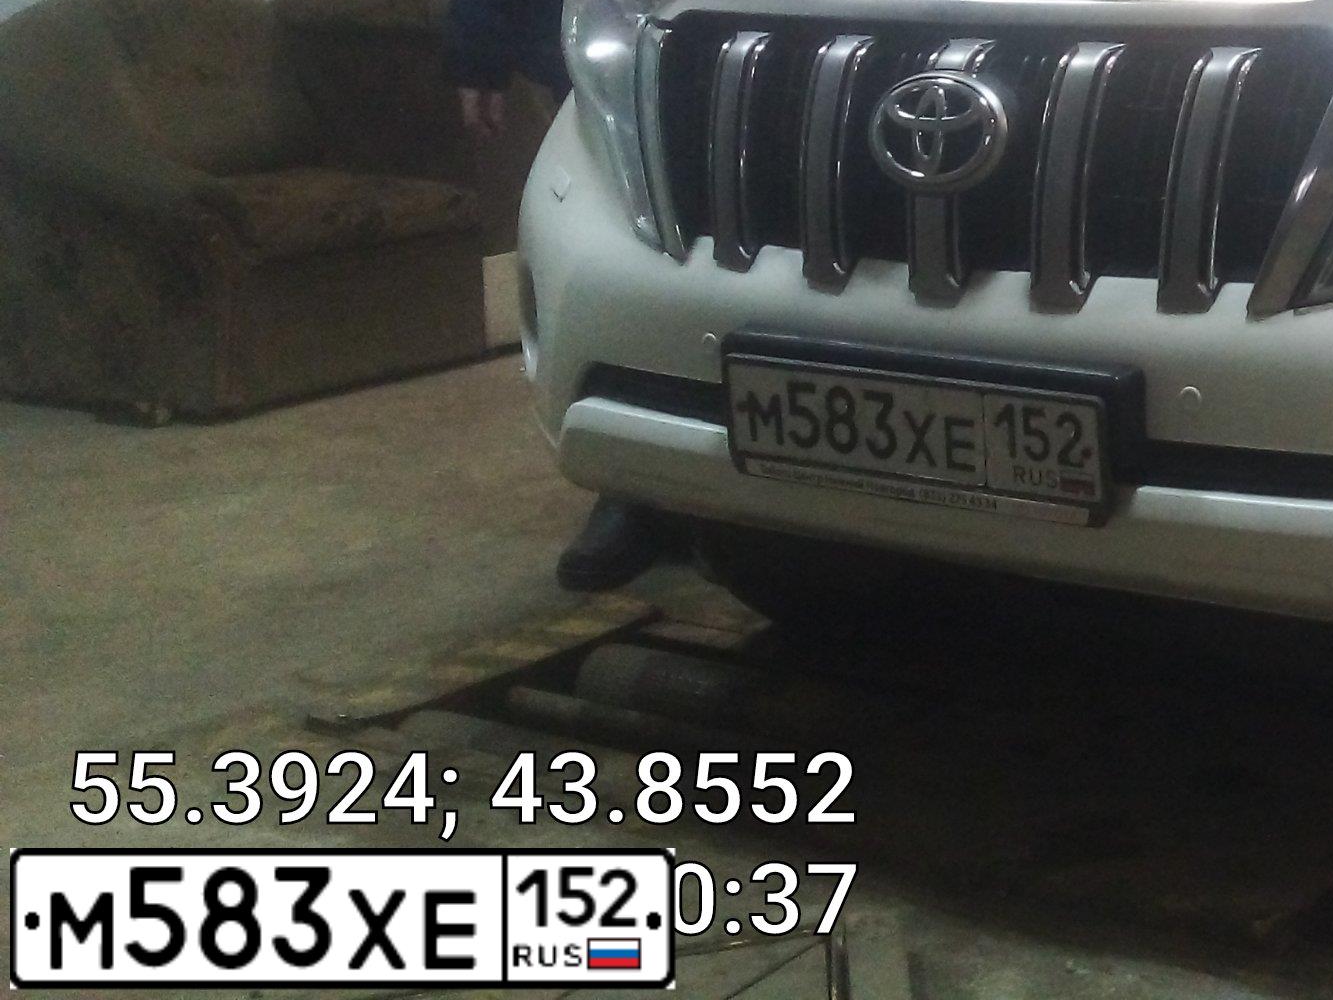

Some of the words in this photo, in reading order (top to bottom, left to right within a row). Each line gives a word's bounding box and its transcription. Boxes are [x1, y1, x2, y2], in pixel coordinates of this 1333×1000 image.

[746, 381, 977, 473] M583XE
[993, 403, 1085, 469] 152
[1013, 465, 1059, 489] RUS
